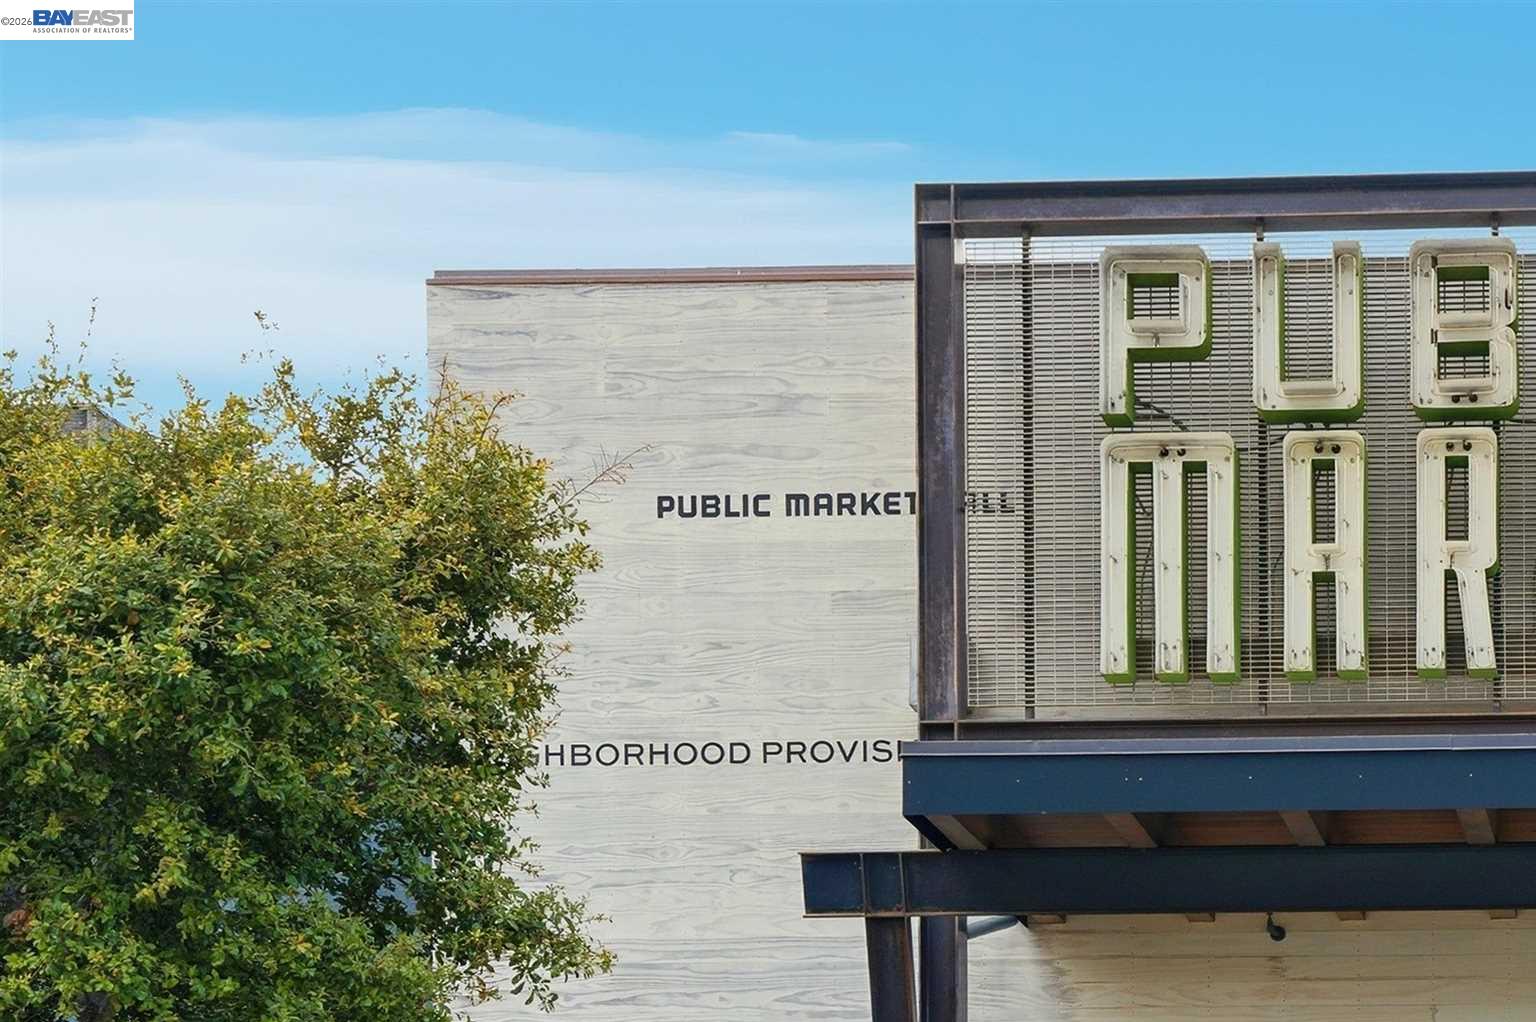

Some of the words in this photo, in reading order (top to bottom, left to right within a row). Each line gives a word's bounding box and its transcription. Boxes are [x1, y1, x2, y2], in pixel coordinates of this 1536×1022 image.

[656, 493, 772, 519] PUBLIC
[784, 490, 917, 517] MARKET
[534, 741, 752, 768] HBORHOOD
[762, 738, 902, 765] PROVISI
